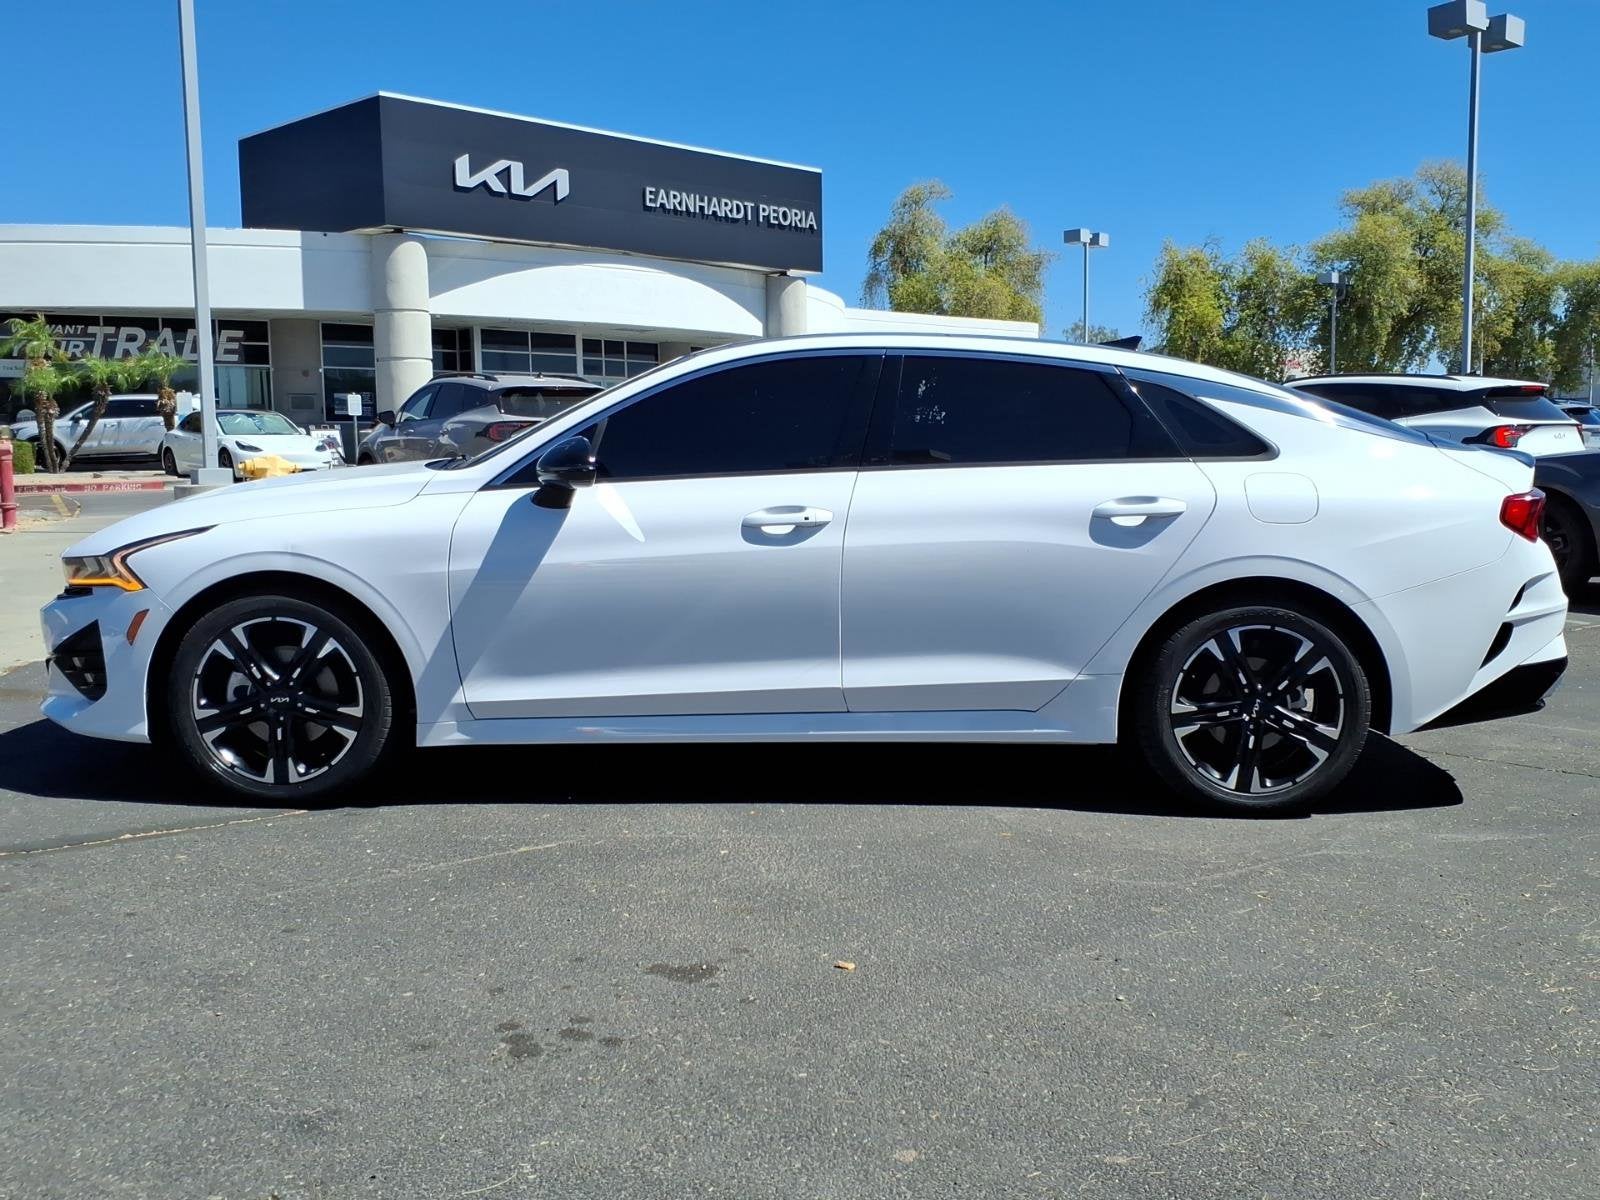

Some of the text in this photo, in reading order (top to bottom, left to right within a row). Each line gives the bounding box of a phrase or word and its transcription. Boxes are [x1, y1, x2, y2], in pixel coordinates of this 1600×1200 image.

[455, 153, 569, 201] KIA
[645, 186, 817, 230] EARNHARDT PEORIA
[11, 340, 85, 358] YUR
[87, 325, 245, 362] TRADE
